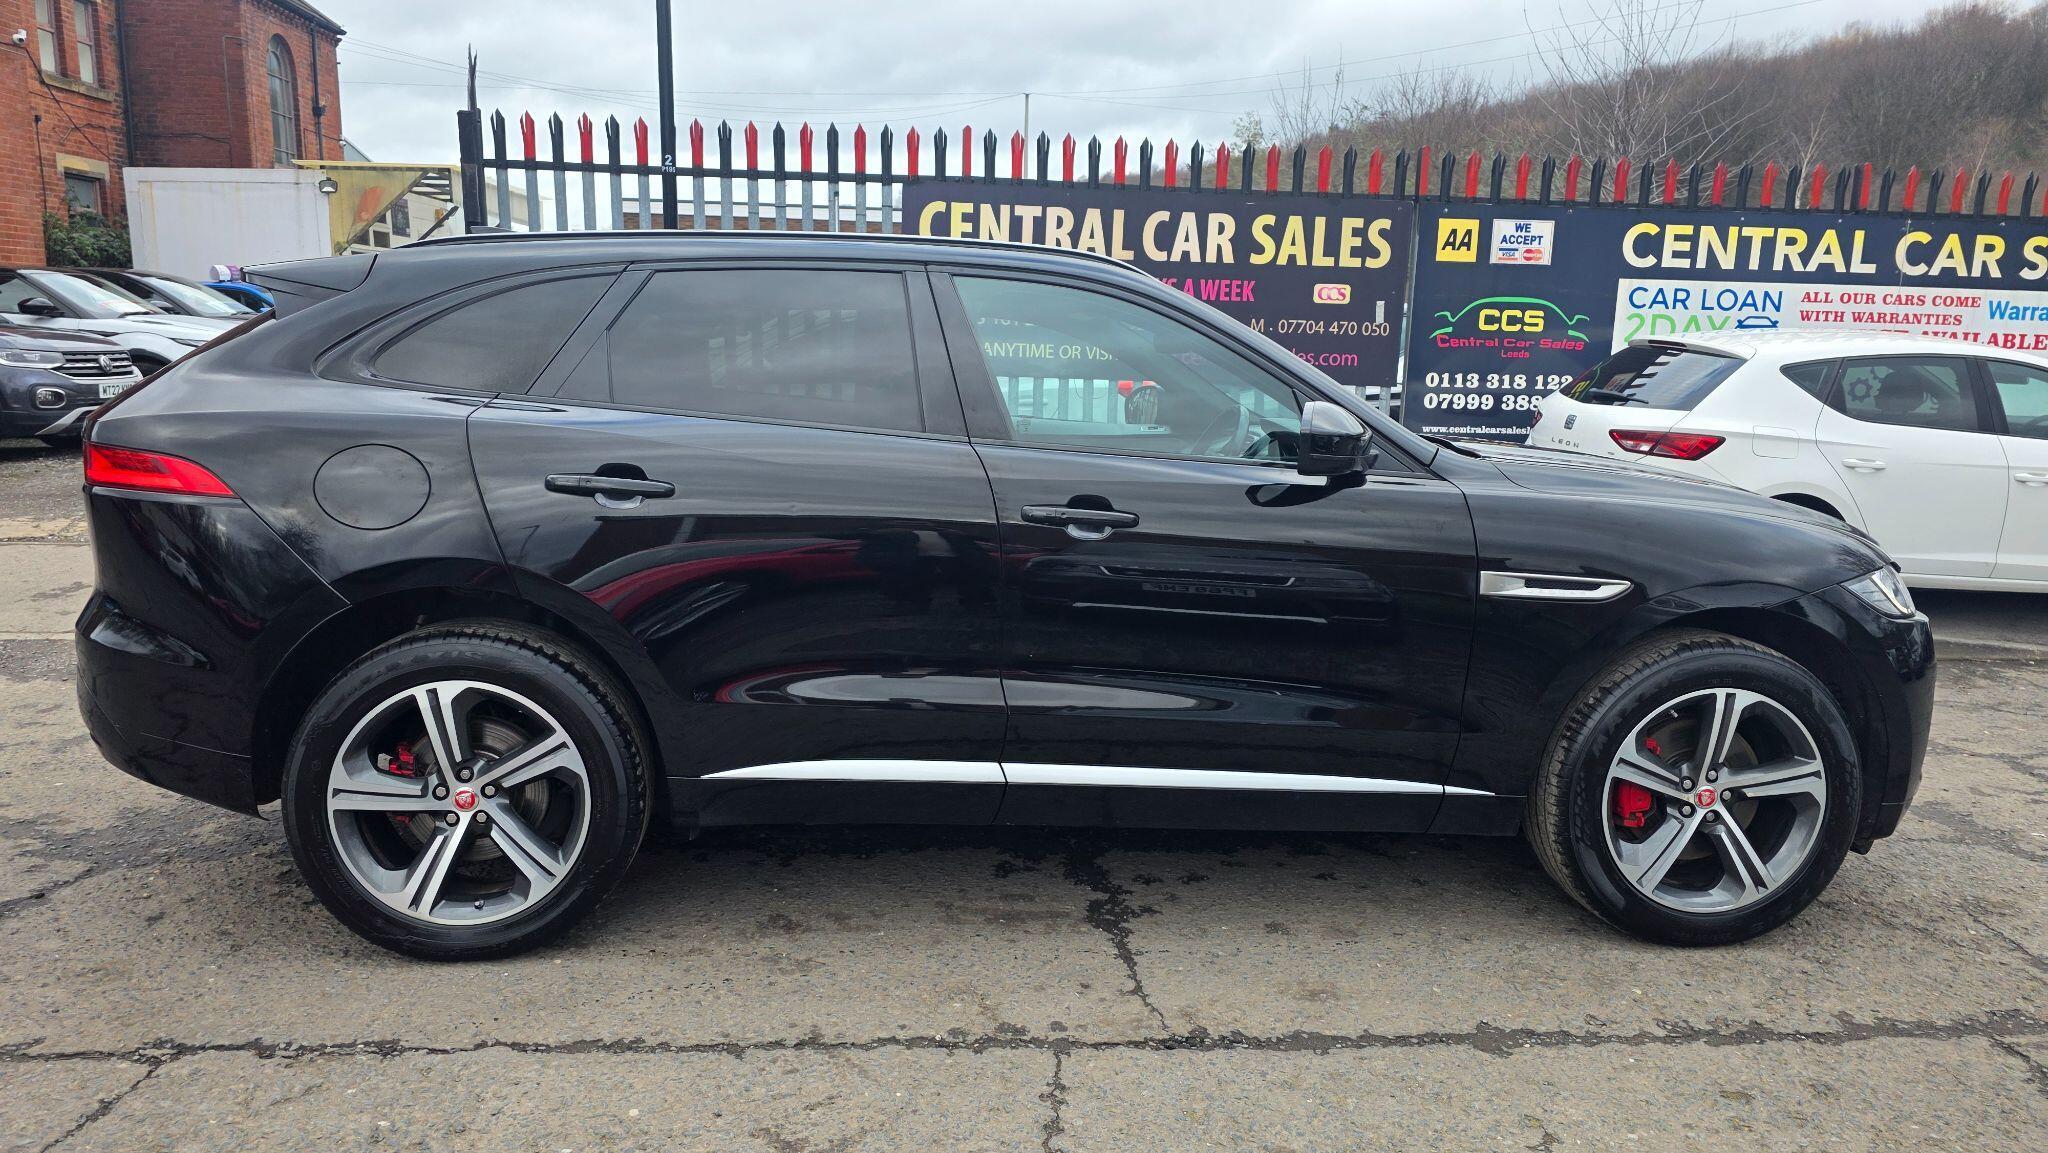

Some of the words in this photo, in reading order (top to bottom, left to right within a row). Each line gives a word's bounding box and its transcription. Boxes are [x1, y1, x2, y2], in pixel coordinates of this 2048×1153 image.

[664, 154, 673, 165] 2
[919, 201, 1134, 261] CENTRAL
[1142, 210, 1235, 263] CAR
[1249, 214, 1393, 269] SALES
[1514, 222, 1532, 234] WE
[1441, 228, 1473, 252] AA
[1500, 234, 1544, 246] ACCEPT
[1622, 222, 1877, 274] CENTRAL
[1894, 231, 2006, 278] CAR
[1183, 278, 1195, 297] A
[1200, 278, 1256, 302] WEEK
[1317, 286, 1347, 302] CCS
[1628, 286, 1691, 311] CAR
[1700, 288, 1783, 313] LOAN
[1801, 291, 1833, 305] ALL
[1839, 292, 1876, 306] OUR
[1882, 293, 1926, 308] CARS
[1931, 295, 1982, 308] COME
[1478, 308, 1545, 333] CCS
[1800, 310, 1845, 324] WITH
[1851, 311, 1963, 326] WARRANTIES
[1278, 320, 1325, 335] 07704
[1328, 321, 1358, 336] 470
[1362, 321, 1390, 337] 050
[1436, 334, 1499, 348] Central
[1503, 338, 1536, 348] Car
[1539, 338, 1585, 351] Sales
[984, 342, 1055, 359] ANYTIME
[1059, 345, 1081, 360] OR
[1087, 346, 1119, 361] VIS
[1501, 350, 1530, 358] Leeds
[1425, 372, 1480, 389] 0113
[1486, 373, 1527, 390] 318
[1423, 392, 1495, 411] 07999
[1501, 394, 1543, 412] 388
[1551, 436, 1580, 449] LEON
